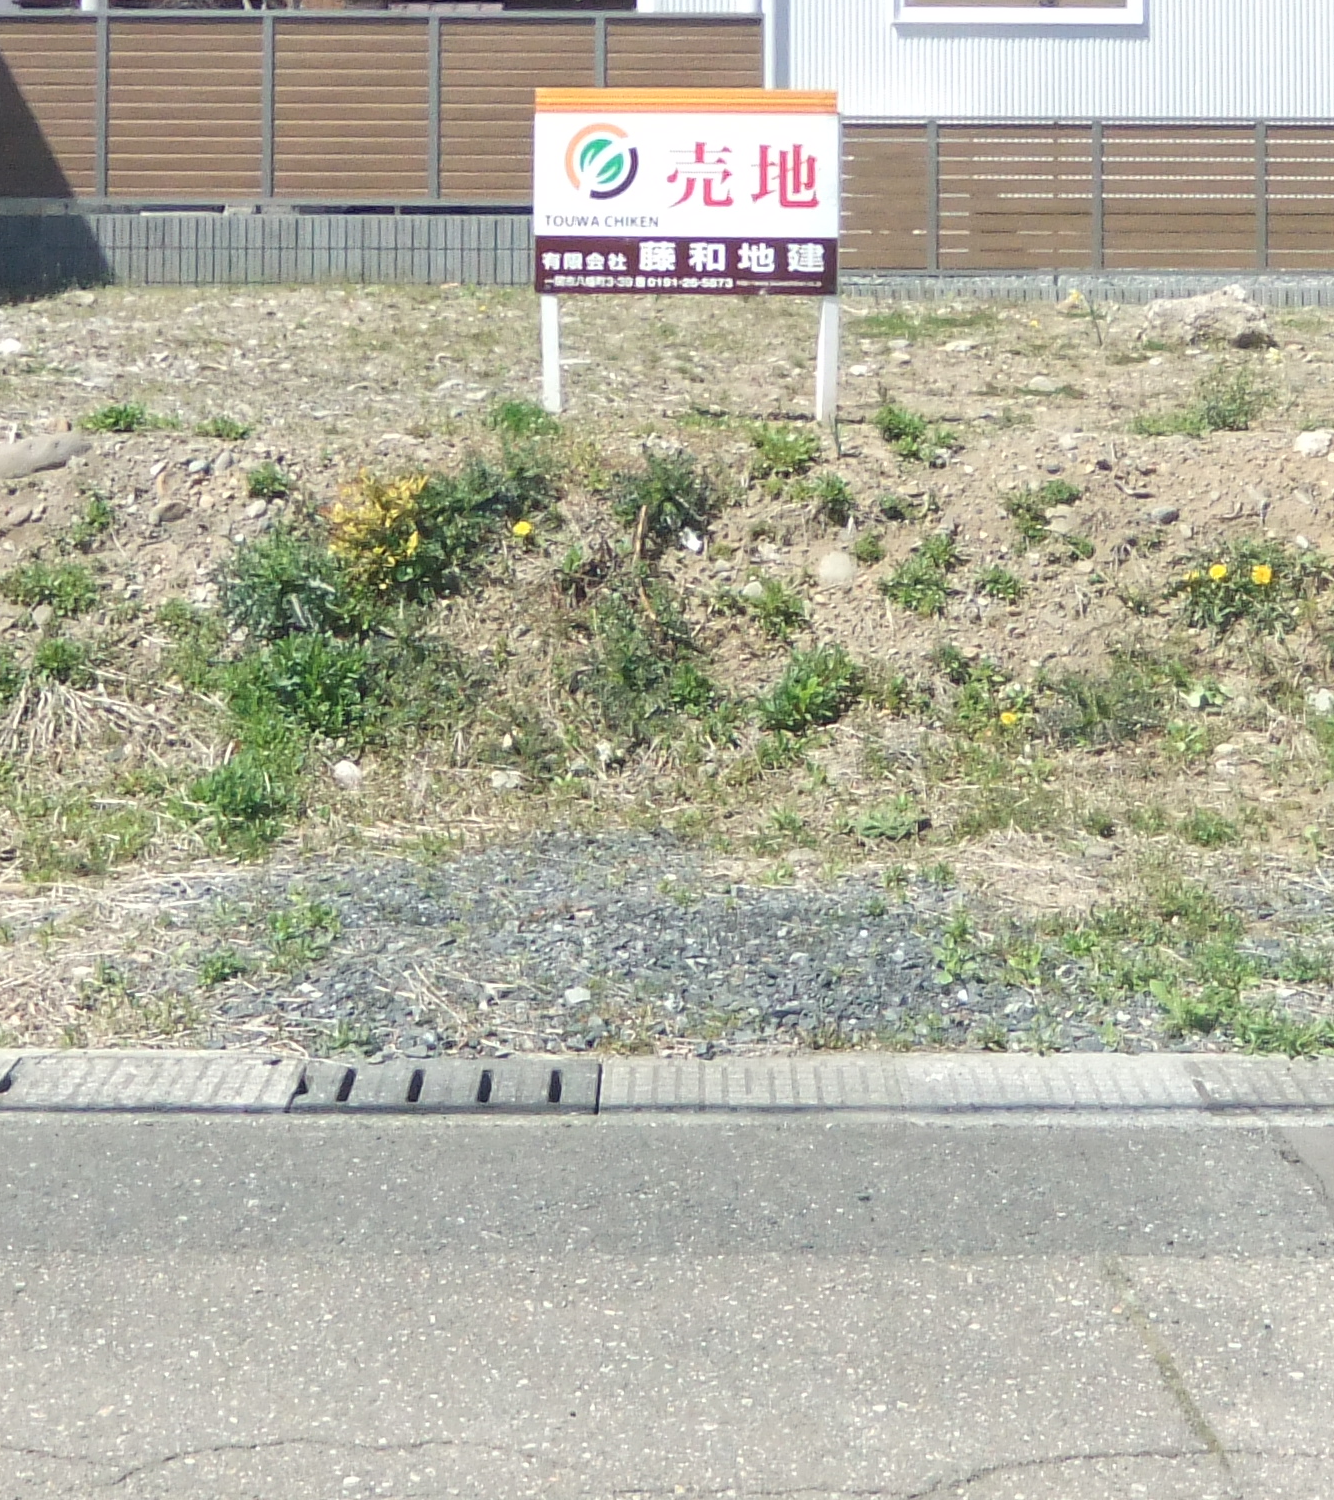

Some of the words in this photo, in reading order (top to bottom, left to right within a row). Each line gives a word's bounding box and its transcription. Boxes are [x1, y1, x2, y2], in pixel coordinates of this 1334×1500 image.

[666, 141, 820, 210] 売地
[545, 214, 600, 228] TOUWA
[604, 215, 659, 229] CHIKEN
[541, 252, 628, 271] 有限会社
[638, 240, 825, 273] 藤和地建
